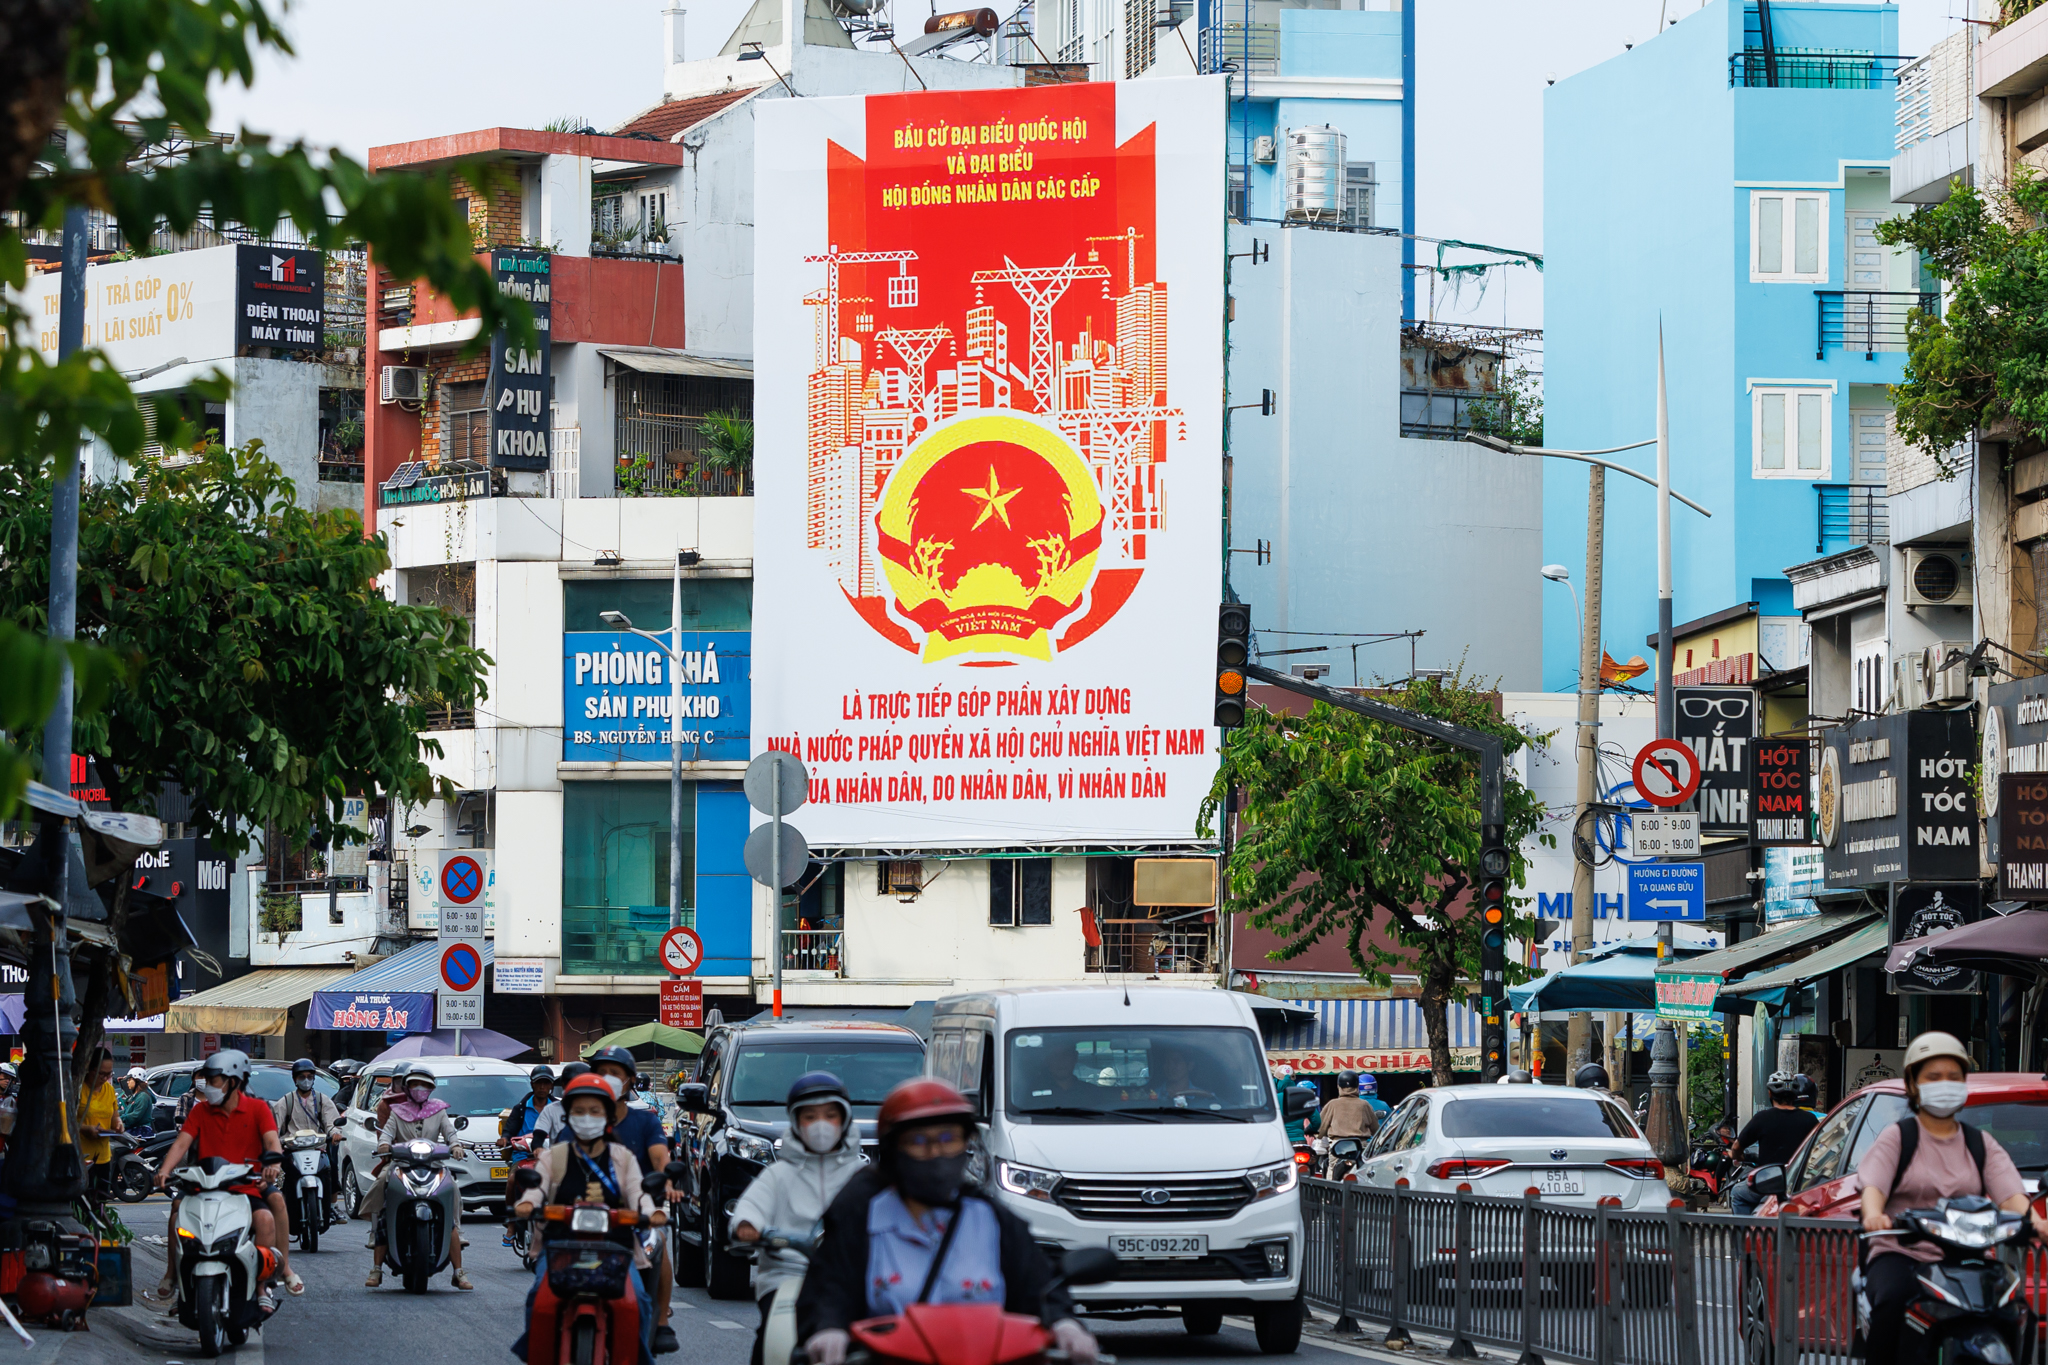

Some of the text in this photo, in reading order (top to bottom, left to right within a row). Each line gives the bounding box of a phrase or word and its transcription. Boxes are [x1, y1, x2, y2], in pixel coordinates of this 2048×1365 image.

[894, 115, 1087, 149] BẦU CỬ ĐẠI BIỂU QUỐC HỘI
[946, 145, 1033, 178] VÀ ĐẠI BIỂU
[882, 171, 1100, 210] HỘI ĐỒNG NHÂN DÂN CÁC CẤP
[498, 254, 550, 274] NHÀ THUỐC
[106, 276, 131, 306] TRẢ
[134, 275, 162, 302] GÓP
[166, 281, 194, 322] 0%
[289, 285, 312, 294] MOBILE
[532, 279, 550, 303] ÂN
[247, 302, 320, 325] ĐIỆN THOẠI
[532, 315, 549, 331] KHÁM
[104, 317, 125, 343] LÃI
[129, 308, 163, 339] SUẤT
[251, 323, 315, 343] MÁY TÍNH
[505, 338, 542, 375] SẢN
[497, 429, 547, 458] KHOA
[469, 478, 485, 496] ÂN
[955, 617, 987, 633] VIỆT
[991, 619, 1021, 633] NAM
[575, 642, 662, 686] PHÒNG
[585, 689, 628, 719] SẢN
[632, 695, 673, 723] PHỤ
[842, 680, 1131, 725] LÀ TRỰC TIẾP GÓP PHẦN XÂY DỰNG
[573, 730, 596, 744] BS.
[599, 723, 656, 744] NGUYỄN
[807, 728, 853, 763] NƯỚC
[858, 729, 903, 762] PHÁP
[909, 724, 964, 763] QUYỀN
[968, 727, 991, 758] XÃ
[996, 726, 1024, 764] HỘI
[1029, 719, 1063, 758] CHỦ
[1068, 725, 1120, 757] NGHĨA
[1125, 724, 1161, 762] VIỆT
[1165, 729, 1205, 755] NAM
[1681, 721, 1747, 772] MẮT
[1759, 745, 1800, 766] HỚT
[1920, 751, 1967, 778] HỚT
[803, 766, 1166, 805] ỦA NHÂN DÂN, DO NHÂN DÂN, VÌ NHÂN DÂN
[1759, 768, 1801, 789] TÓC
[81, 788, 111, 802] MOBIL
[1921, 786, 1967, 812] TÓC
[2017, 781, 2048, 801] HỚ
[1758, 795, 1803, 812] NAM
[1641, 819, 1691, 831] 6:00 9:00
[1756, 814, 1805, 840] THANH LIÊM
[1639, 838, 1694, 850] 16:00 19:00
[1917, 826, 1971, 846] NAM
[2017, 835, 2048, 850] NA
[198, 860, 227, 890] Mới
[1633, 868, 1661, 878] HƯỚNG
[1671, 866, 1698, 878] ĐƯỜNG
[2006, 863, 2043, 889] THANH
[1639, 880, 1694, 893] TẠ QUANG BỬU
[1537, 892, 1624, 919] MIH
[673, 982, 690, 993] CẤM
[354, 993, 390, 1004] NHÀ THUỐC
[333, 1002, 408, 1029] HỒNG ÂN
[1332, 1052, 1432, 1070] NGHĨA
[1546, 1171, 1569, 1182] 65A
[1540, 1182, 1579, 1193] 410.80
[1118, 1238, 1200, 1252] 95C-092.20
